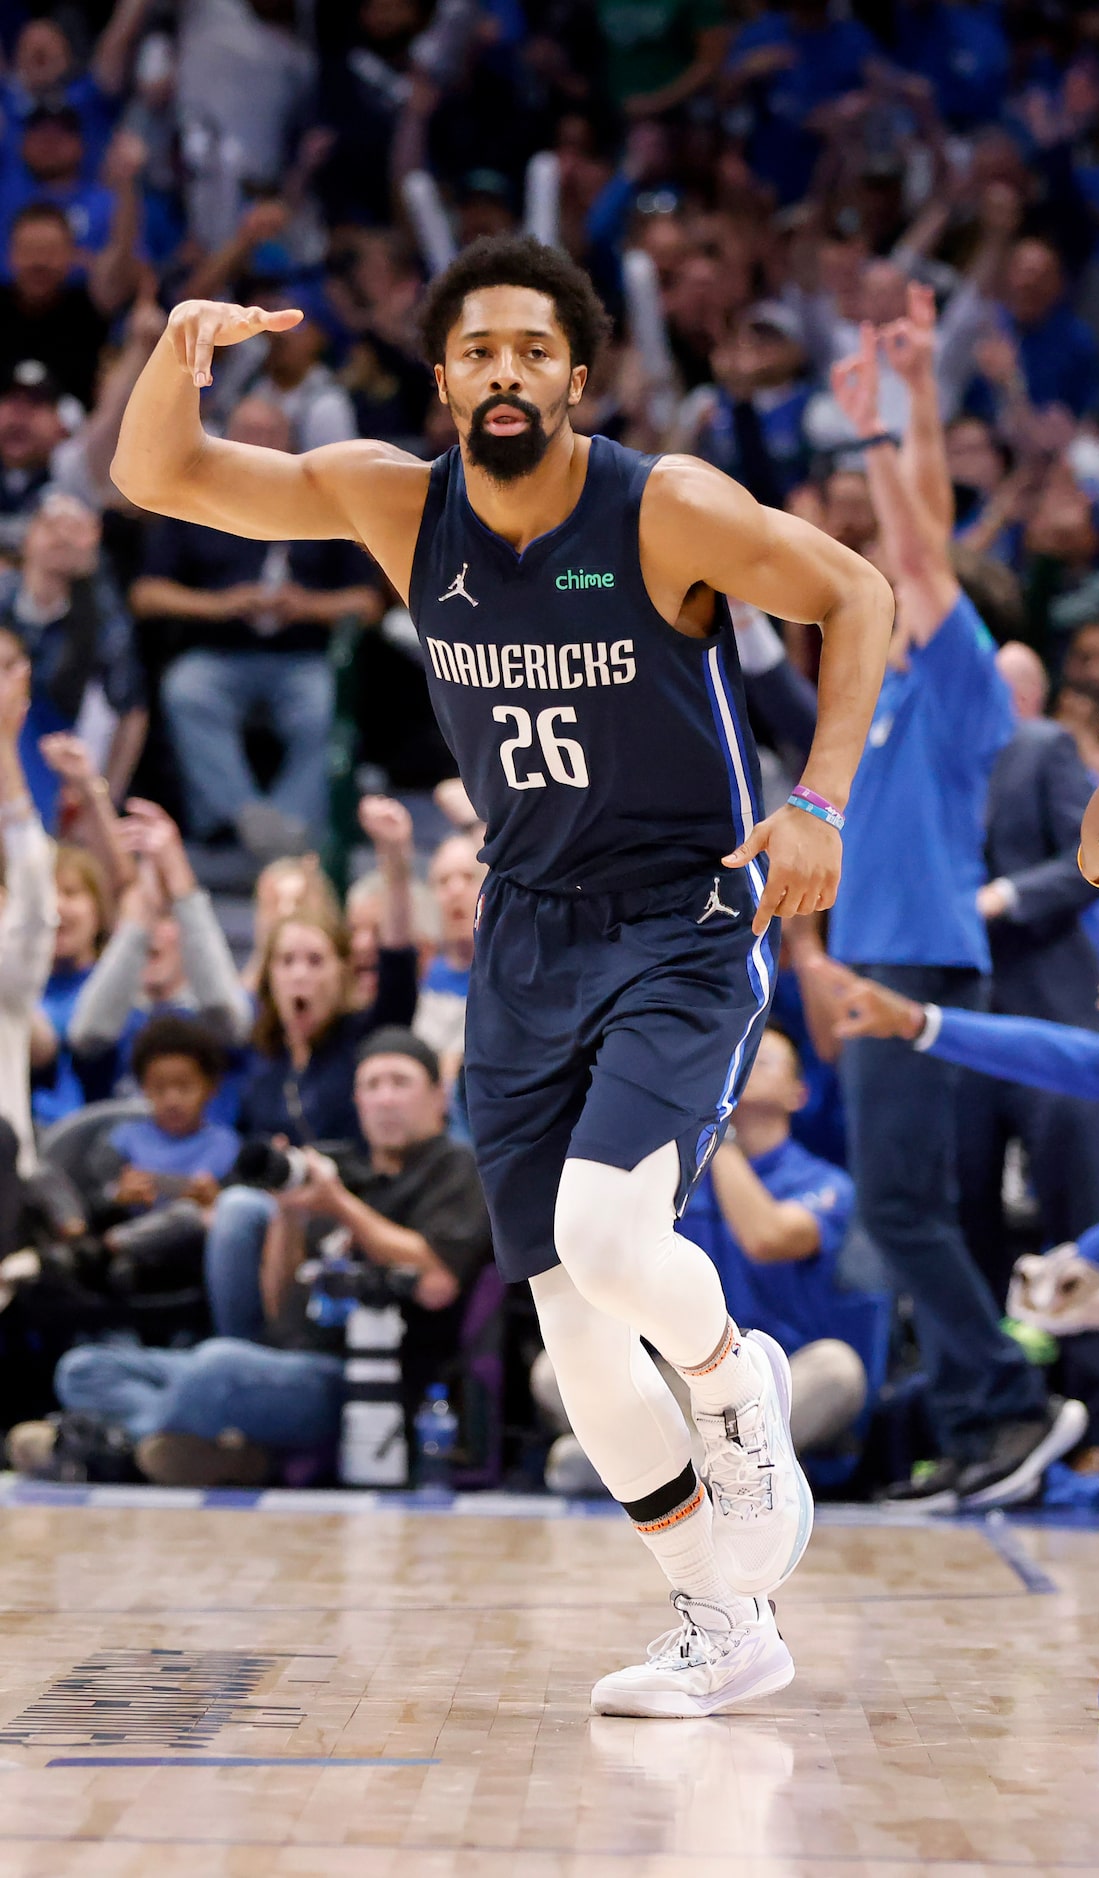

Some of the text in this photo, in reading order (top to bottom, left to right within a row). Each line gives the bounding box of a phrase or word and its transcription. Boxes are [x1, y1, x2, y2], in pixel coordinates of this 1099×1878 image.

[555, 569, 615, 590] chime
[426, 636, 637, 690] MAVERICKS
[492, 705, 589, 790] 26
